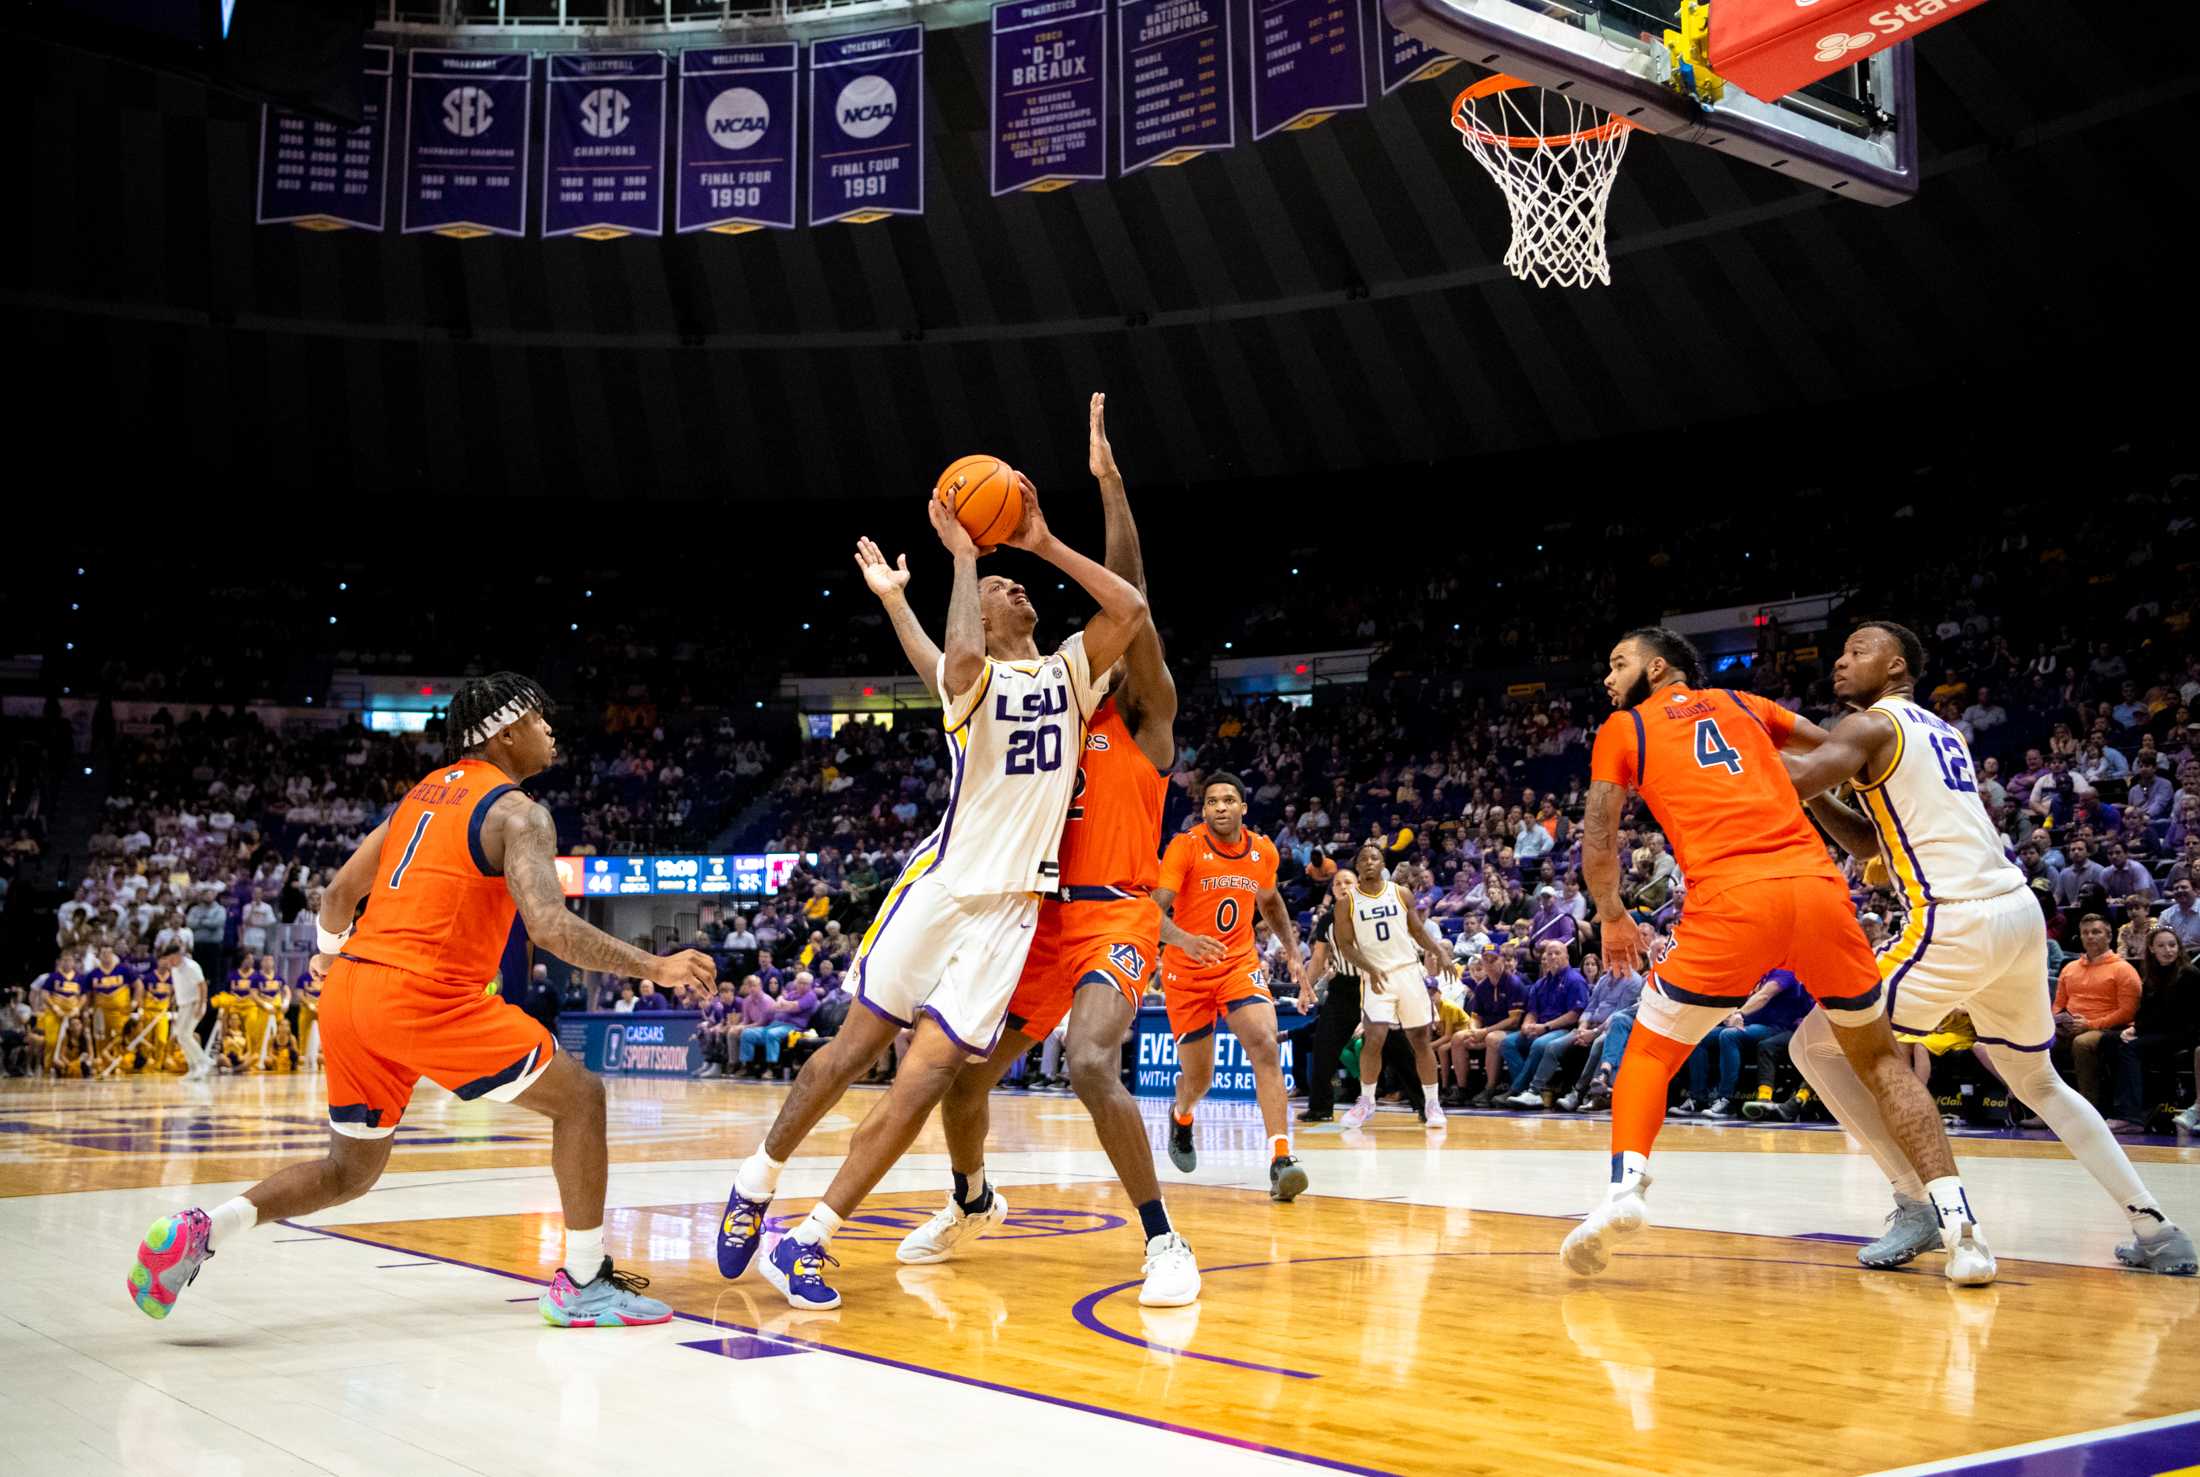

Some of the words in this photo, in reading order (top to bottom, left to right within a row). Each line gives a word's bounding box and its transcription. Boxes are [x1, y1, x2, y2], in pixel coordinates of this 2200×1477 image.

[1146, 1, 1200, 26] NATIONAL
[1140, 11, 1208, 42] CHAMPIONS
[1012, 56, 1086, 86] BREAUX
[441, 86, 494, 137] SEC
[580, 87, 631, 138] SEC
[844, 103, 894, 124] NCAA
[713, 117, 767, 133] NCAA
[574, 145, 636, 157] CHAMPIONS
[700, 172, 736, 186] FINAL
[739, 170, 772, 184] FOUR
[832, 161, 865, 178] FINAL
[868, 156, 900, 174] FOUR
[711, 187, 760, 208] 1990
[844, 174, 886, 199] 1991
[995, 684, 1068, 722] LSU
[1005, 724, 1062, 776] 20
[1694, 718, 1743, 776] 4
[1929, 732, 1976, 792] 12
[389, 811, 434, 889] 1
[588, 875, 612, 892] 44
[687, 878, 697, 892] 2
[1201, 876, 1258, 892] TIGERS
[1216, 897, 1240, 934] 0
[1360, 905, 1398, 922] LSU
[1375, 921, 1390, 942] 0
[626, 1026, 664, 1042] CAESARS
[624, 1045, 688, 1070] SPORTSBOOK
[1139, 1070, 1170, 1088] WITH
